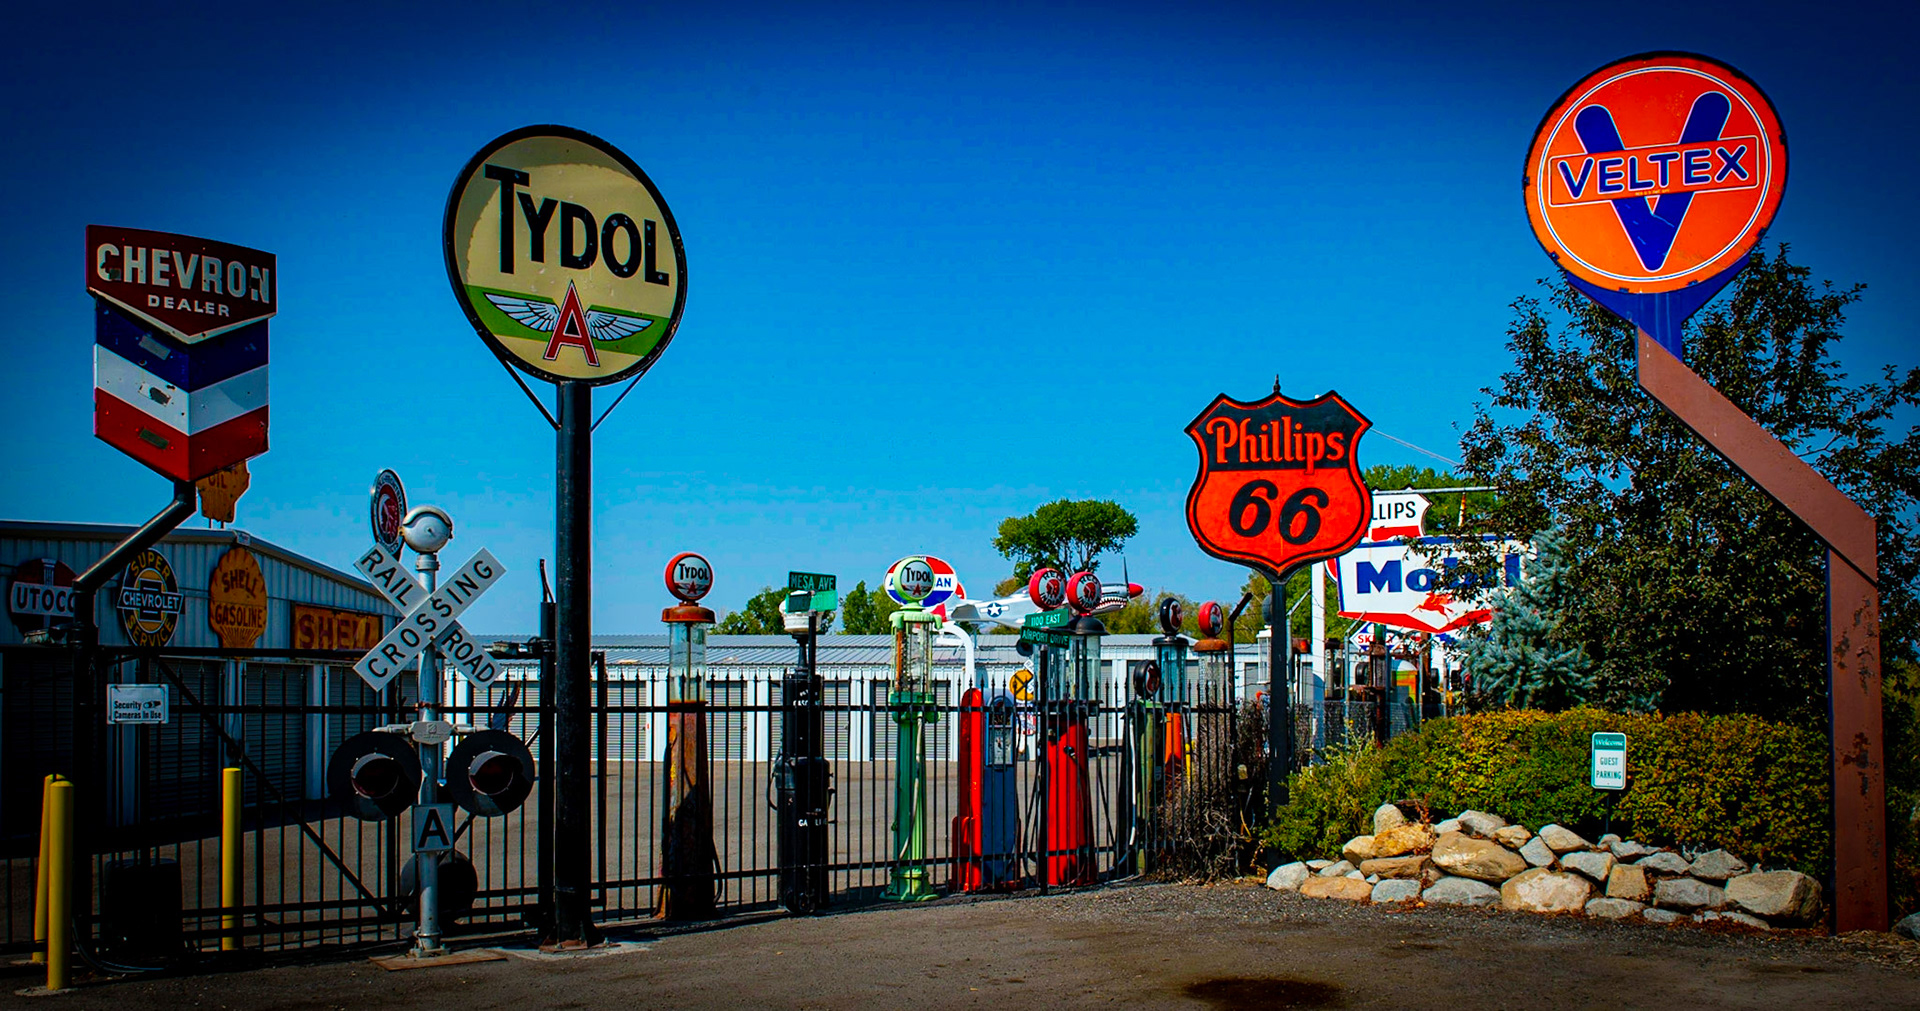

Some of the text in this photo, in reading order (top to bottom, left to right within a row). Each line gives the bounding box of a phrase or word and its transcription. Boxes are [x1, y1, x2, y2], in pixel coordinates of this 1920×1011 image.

[1557, 145, 1749, 199] VELTEX
[483, 163, 669, 287] TYDOL
[96, 243, 270, 304] CHEVRON
[147, 294, 230, 317] DEALER
[543, 279, 600, 367] A
[1206, 416, 1345, 475] Phillips
[1229, 479, 1329, 545] 66
[1372, 501, 1417, 520] LIPS
[130, 551, 171, 581] SUPER
[679, 563, 708, 580] TYDOL
[905, 567, 932, 582] TYDOL
[222, 568, 258, 598] SHELL
[361, 552, 414, 606] RAIL
[791, 574, 835, 591] MESA AVE
[122, 591, 180, 610] CHEVROLET
[215, 605, 263, 628] GASOLINE
[367, 560, 493, 678] CROSSING
[1031, 613, 1061, 627] 1100 EAST
[127, 617, 174, 647] SERVICE
[1022, 629, 1069, 645] AIRPORT DRIVE
[442, 629, 495, 682] ROAD
[114, 700, 142, 710] Security
[114, 711, 142, 719] Cameras
[151, 711, 162, 719] Use
[1595, 738, 1624, 746] Welcome
[1600, 757, 1619, 766] GUEST
[1596, 770, 1622, 780] PARKING
[417, 808, 451, 848] A
